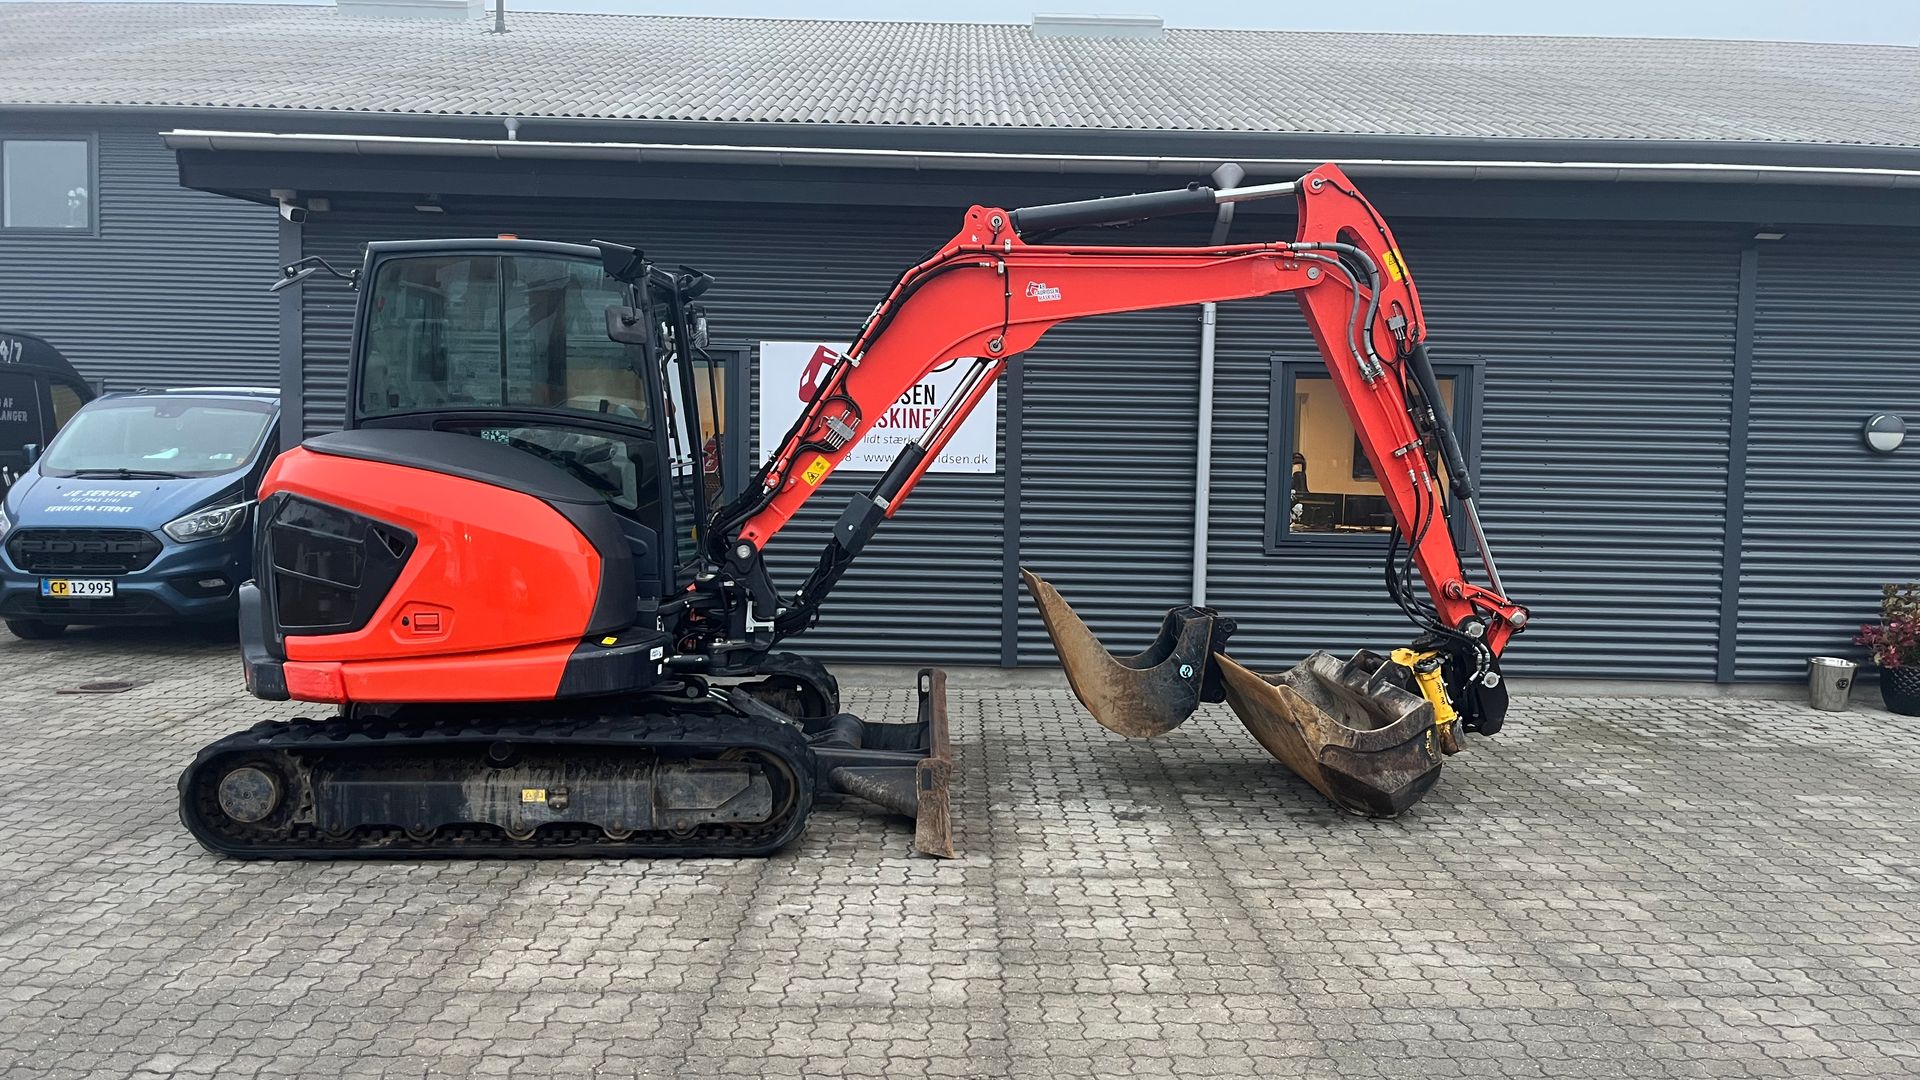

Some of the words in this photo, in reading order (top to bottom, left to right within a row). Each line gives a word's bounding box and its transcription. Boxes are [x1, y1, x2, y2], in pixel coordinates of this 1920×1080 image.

[873, 408, 941, 429] SKINE
[864, 434, 880, 444] lidt
[82, 490, 142, 498] SERVICE
[51, 582, 67, 593] CP
[72, 582, 86, 593] 12
[88, 582, 112, 594] 995
